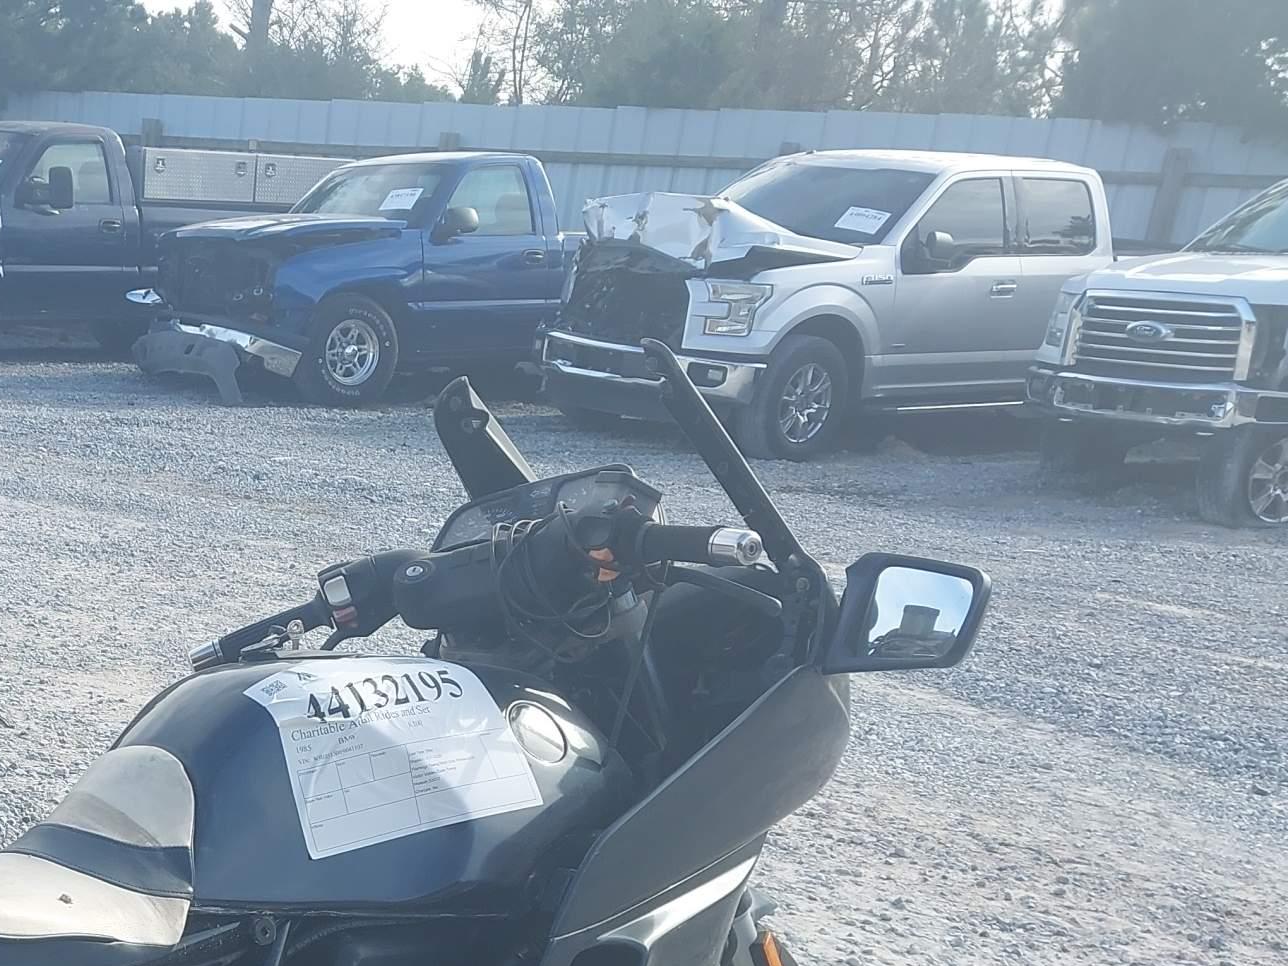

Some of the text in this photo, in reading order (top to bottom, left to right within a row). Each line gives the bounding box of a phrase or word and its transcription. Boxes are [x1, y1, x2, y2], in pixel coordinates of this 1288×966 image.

[305, 669, 463, 724] 44132195
[291, 722, 345, 742] Charitable
[296, 744, 312, 754] 1985
